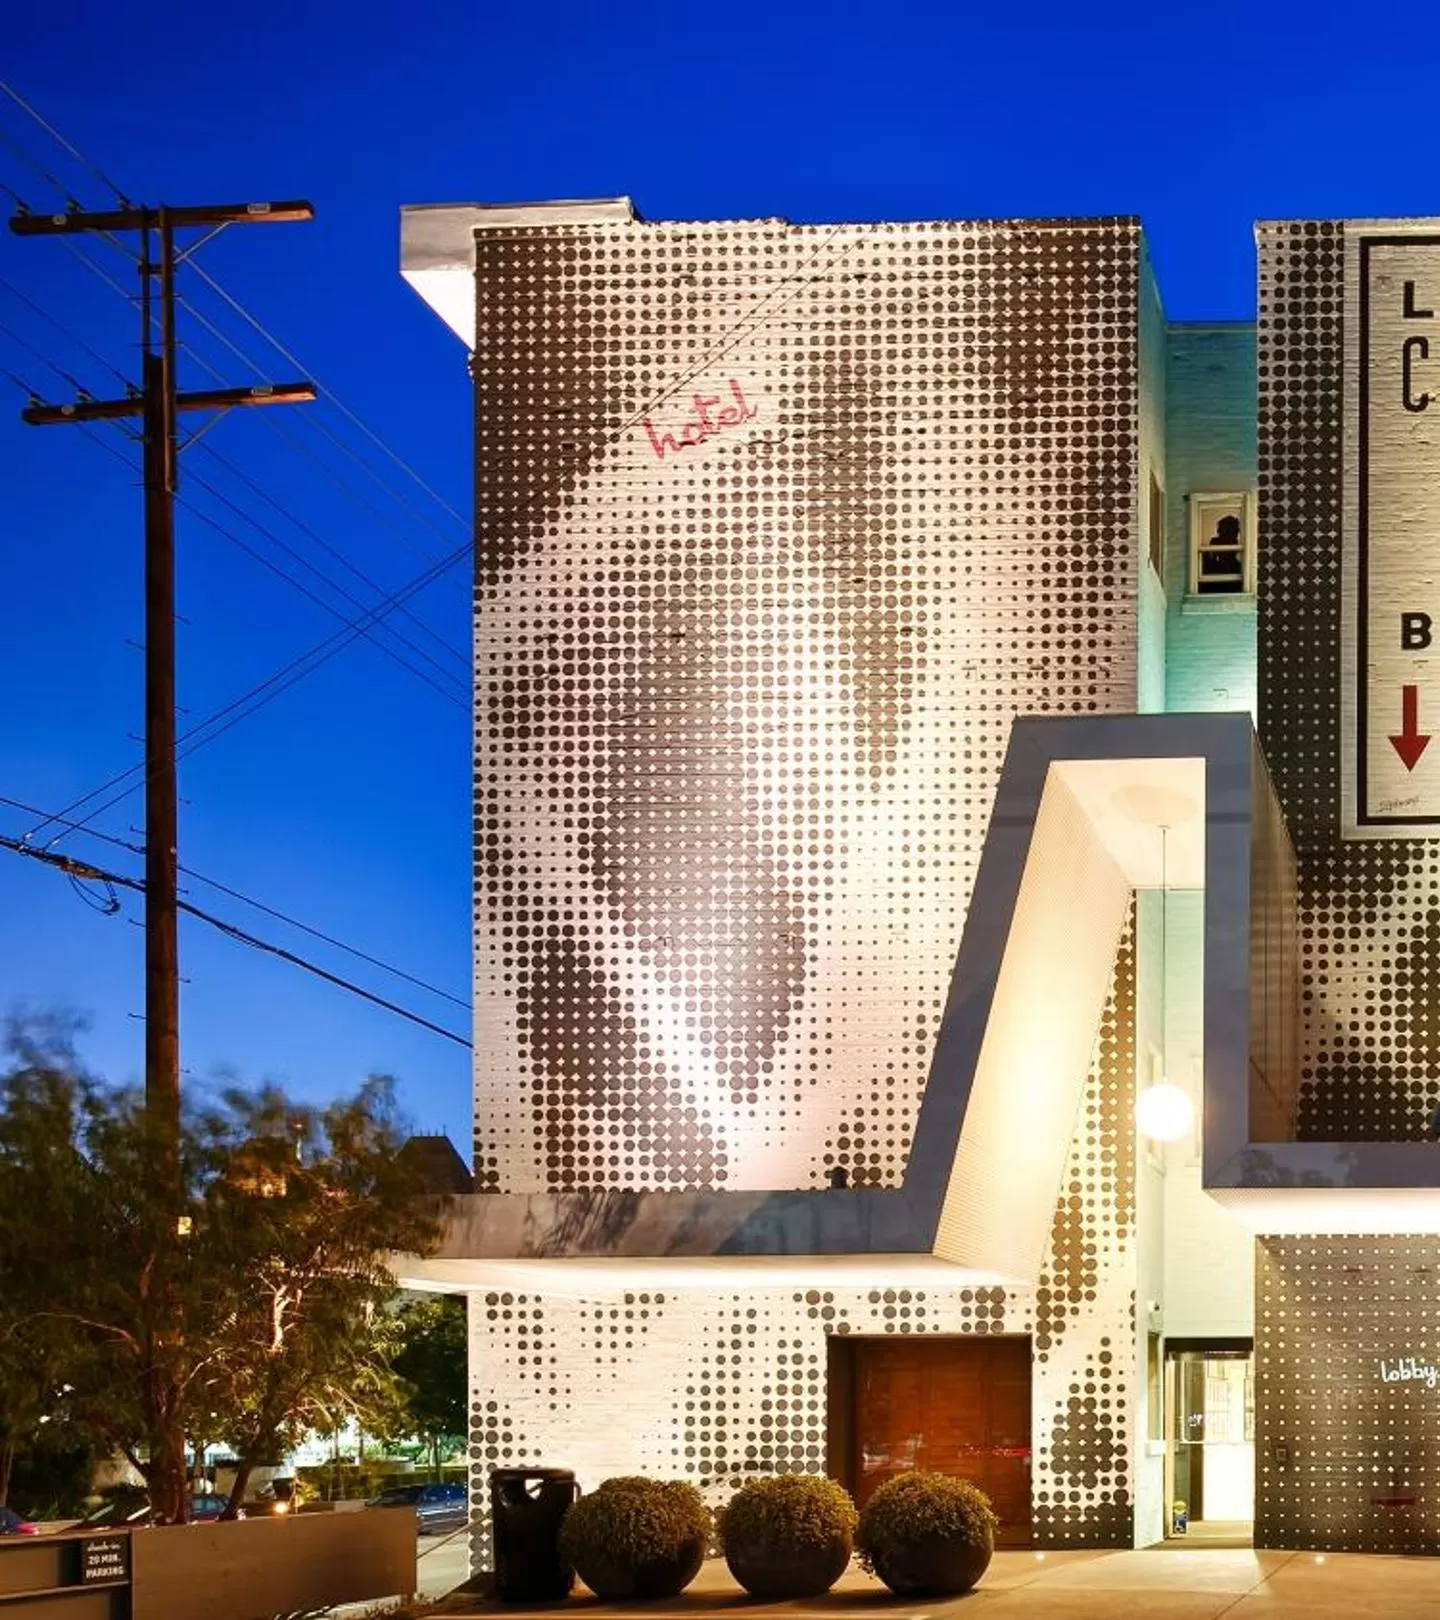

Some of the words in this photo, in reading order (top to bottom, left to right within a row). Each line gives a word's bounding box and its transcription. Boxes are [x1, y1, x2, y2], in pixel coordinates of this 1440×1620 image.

[643, 378, 757, 459] hotel
[1381, 1357, 1438, 1389] lobby
[86, 1566, 124, 1578] PARKING
